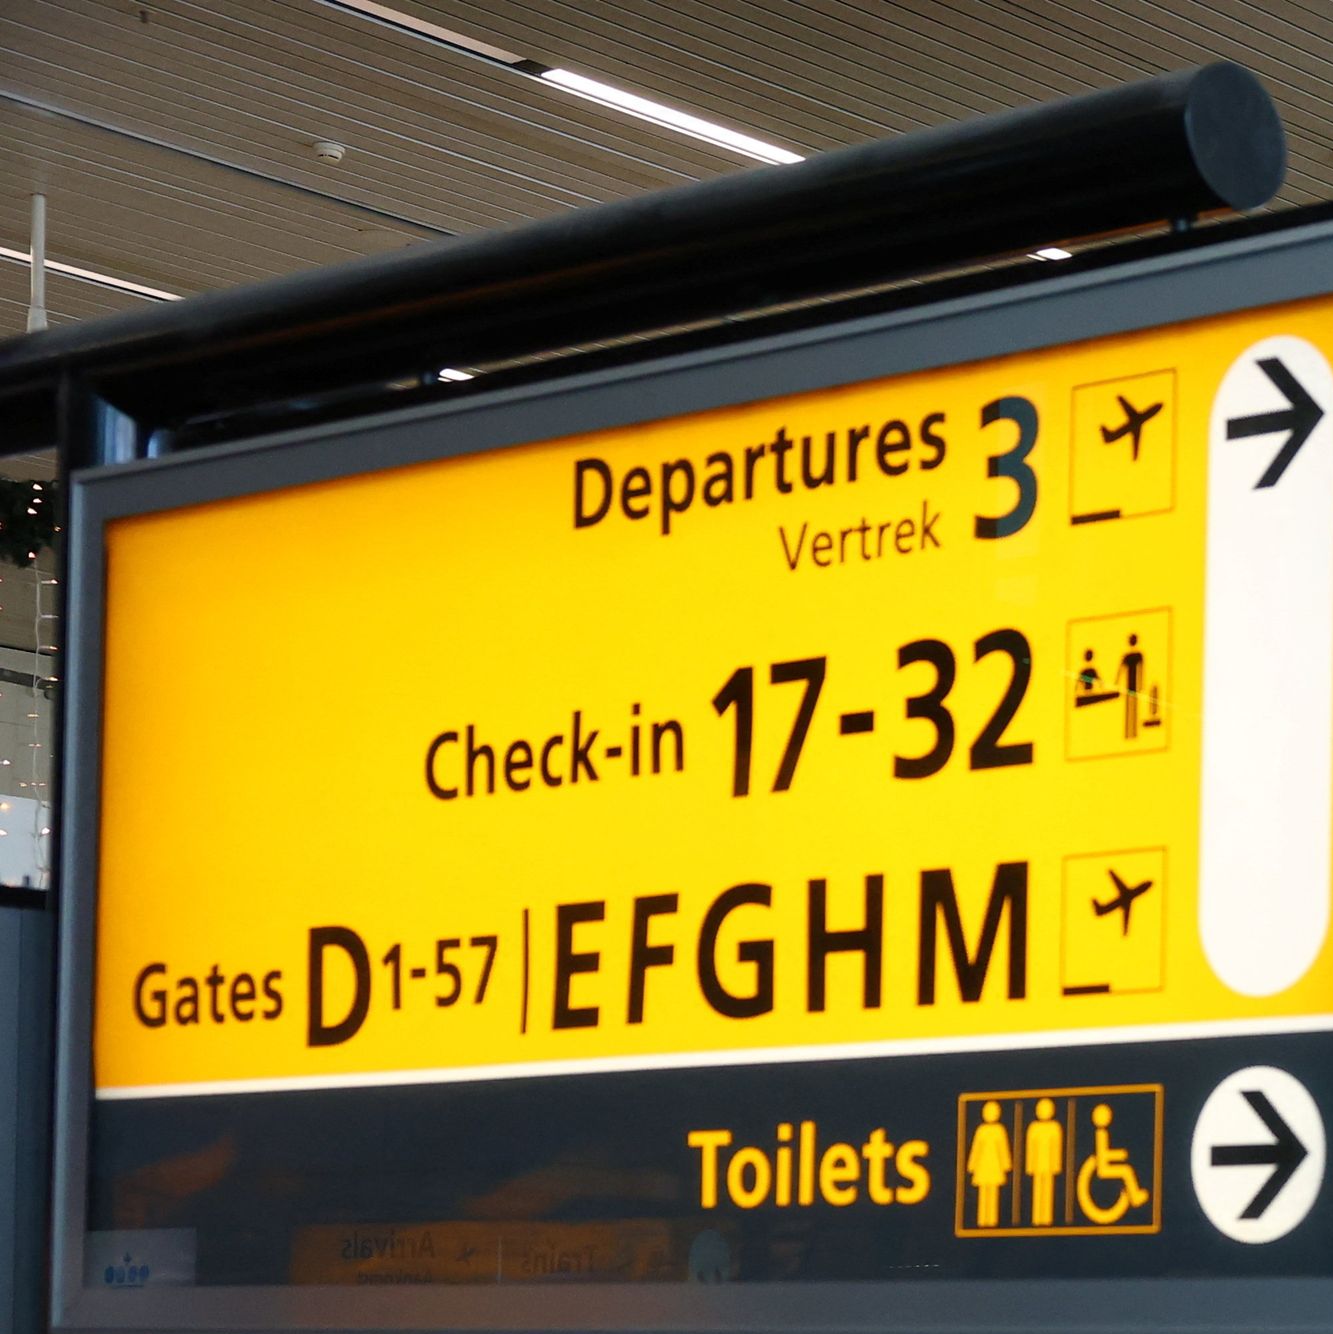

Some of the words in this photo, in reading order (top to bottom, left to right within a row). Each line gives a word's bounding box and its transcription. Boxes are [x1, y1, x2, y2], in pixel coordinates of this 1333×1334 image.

[572, 409, 946, 535] Departures
[975, 396, 1040, 540] 3
[778, 504, 940, 571] Vertrek
[422, 702, 685, 802] Check-in
[710, 625, 1035, 798] 17-32
[134, 956, 284, 1035] Gates
[690, 1122, 931, 1210] Toilets
